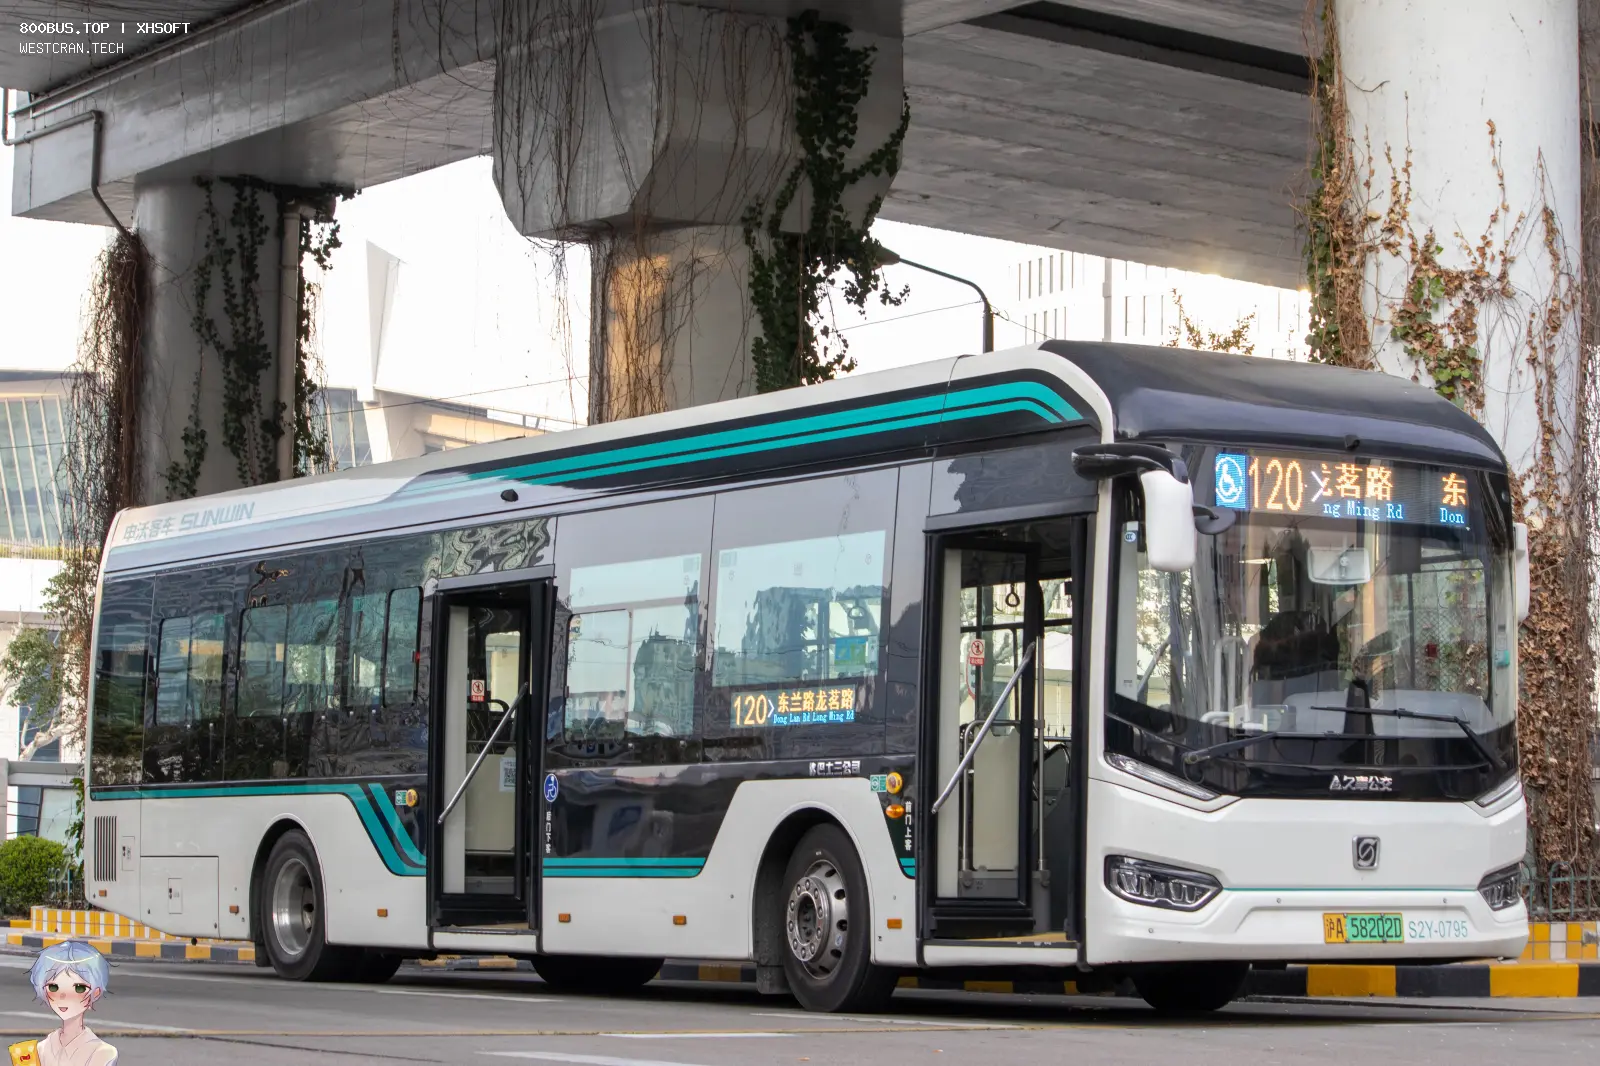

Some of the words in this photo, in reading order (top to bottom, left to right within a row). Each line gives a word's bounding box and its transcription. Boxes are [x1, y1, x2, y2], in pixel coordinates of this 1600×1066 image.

[1248, 457, 1303, 511] 120
[1441, 472, 1467, 507] 东
[123, 516, 177, 542] 申沃客车
[178, 502, 256, 531] SUNWIN
[1347, 500, 1380, 520] Ming
[1386, 503, 1404, 520] Rd
[733, 694, 768, 726] 120
[777, 688, 855, 713] 东兰路龙茗路
[773, 713, 788, 725] Dong
[789, 712, 801, 723] Lan
[812, 711, 828, 724] Long
[1408, 920, 1468, 939] S2Y-0795
